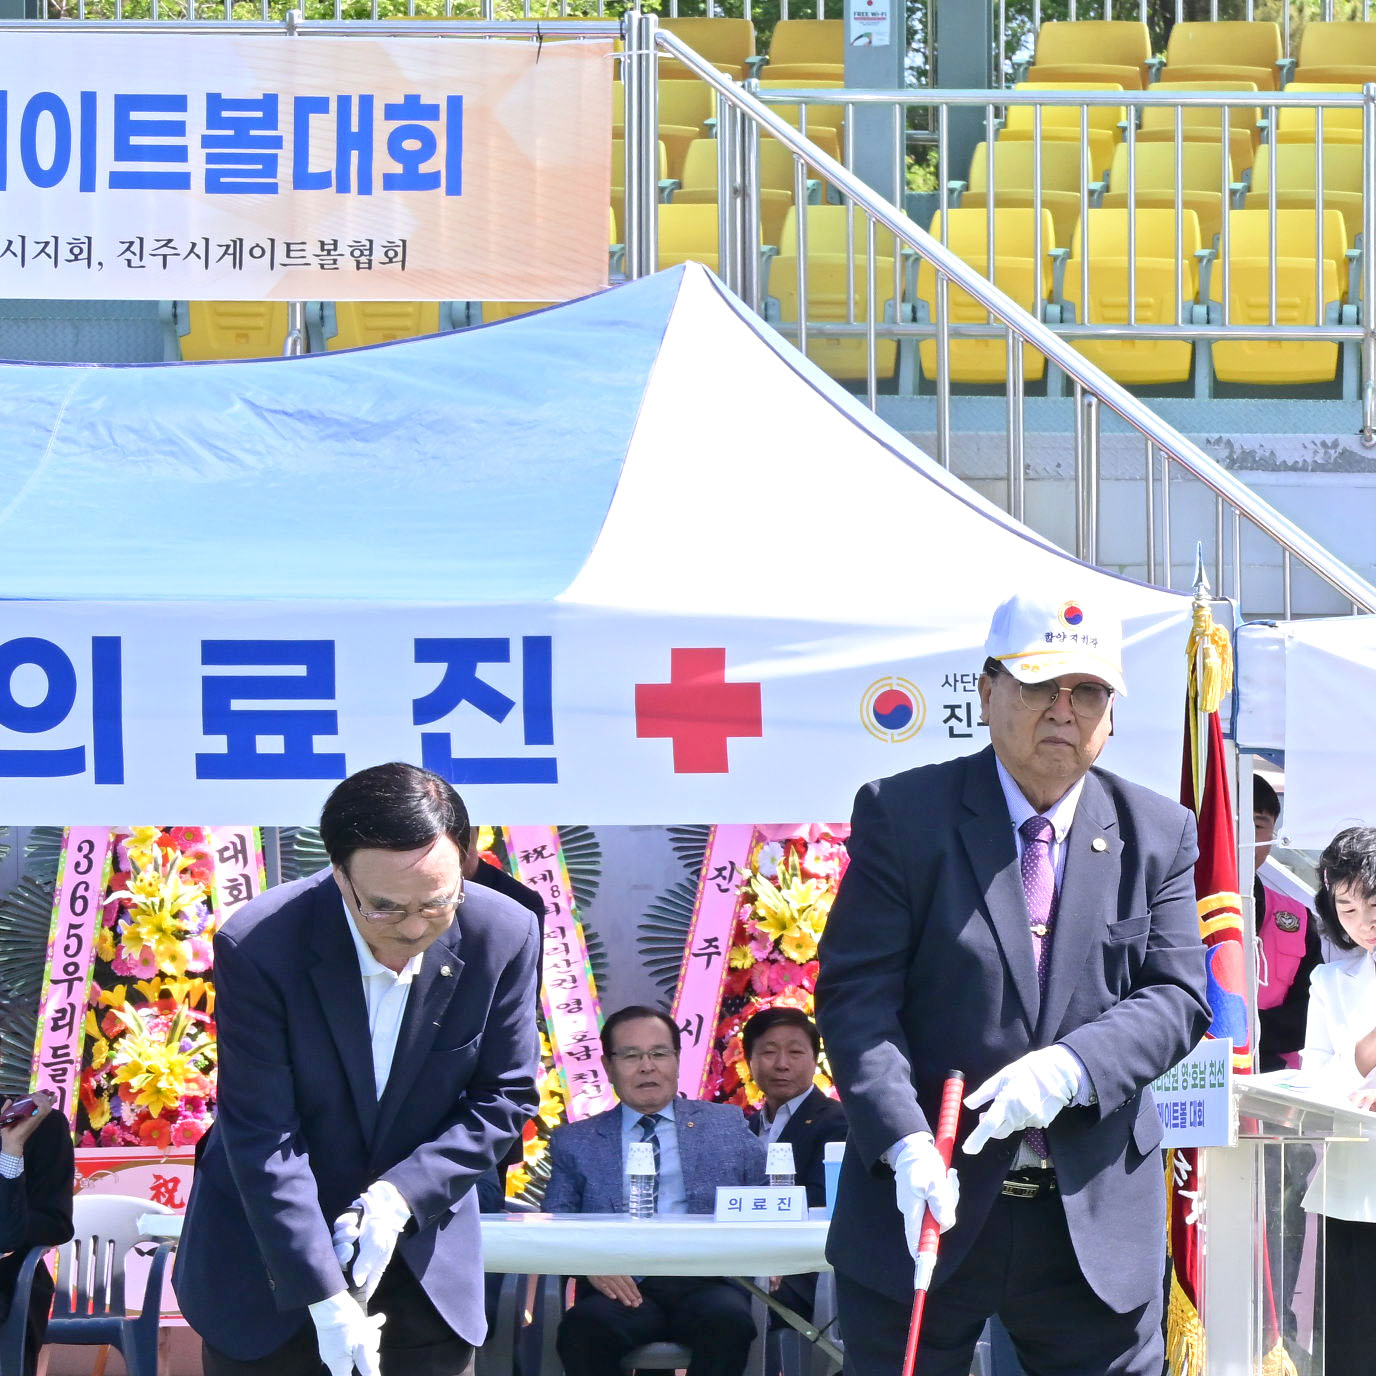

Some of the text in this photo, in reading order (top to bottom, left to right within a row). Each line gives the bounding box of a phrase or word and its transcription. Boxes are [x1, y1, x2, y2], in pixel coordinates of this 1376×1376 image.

[0, 90, 464, 197] 이트볼대회
[116, 236, 408, 272] 진주시게이트볼협회
[216, 833, 254, 907] 대회
[149, 1173, 185, 1210] 祝
